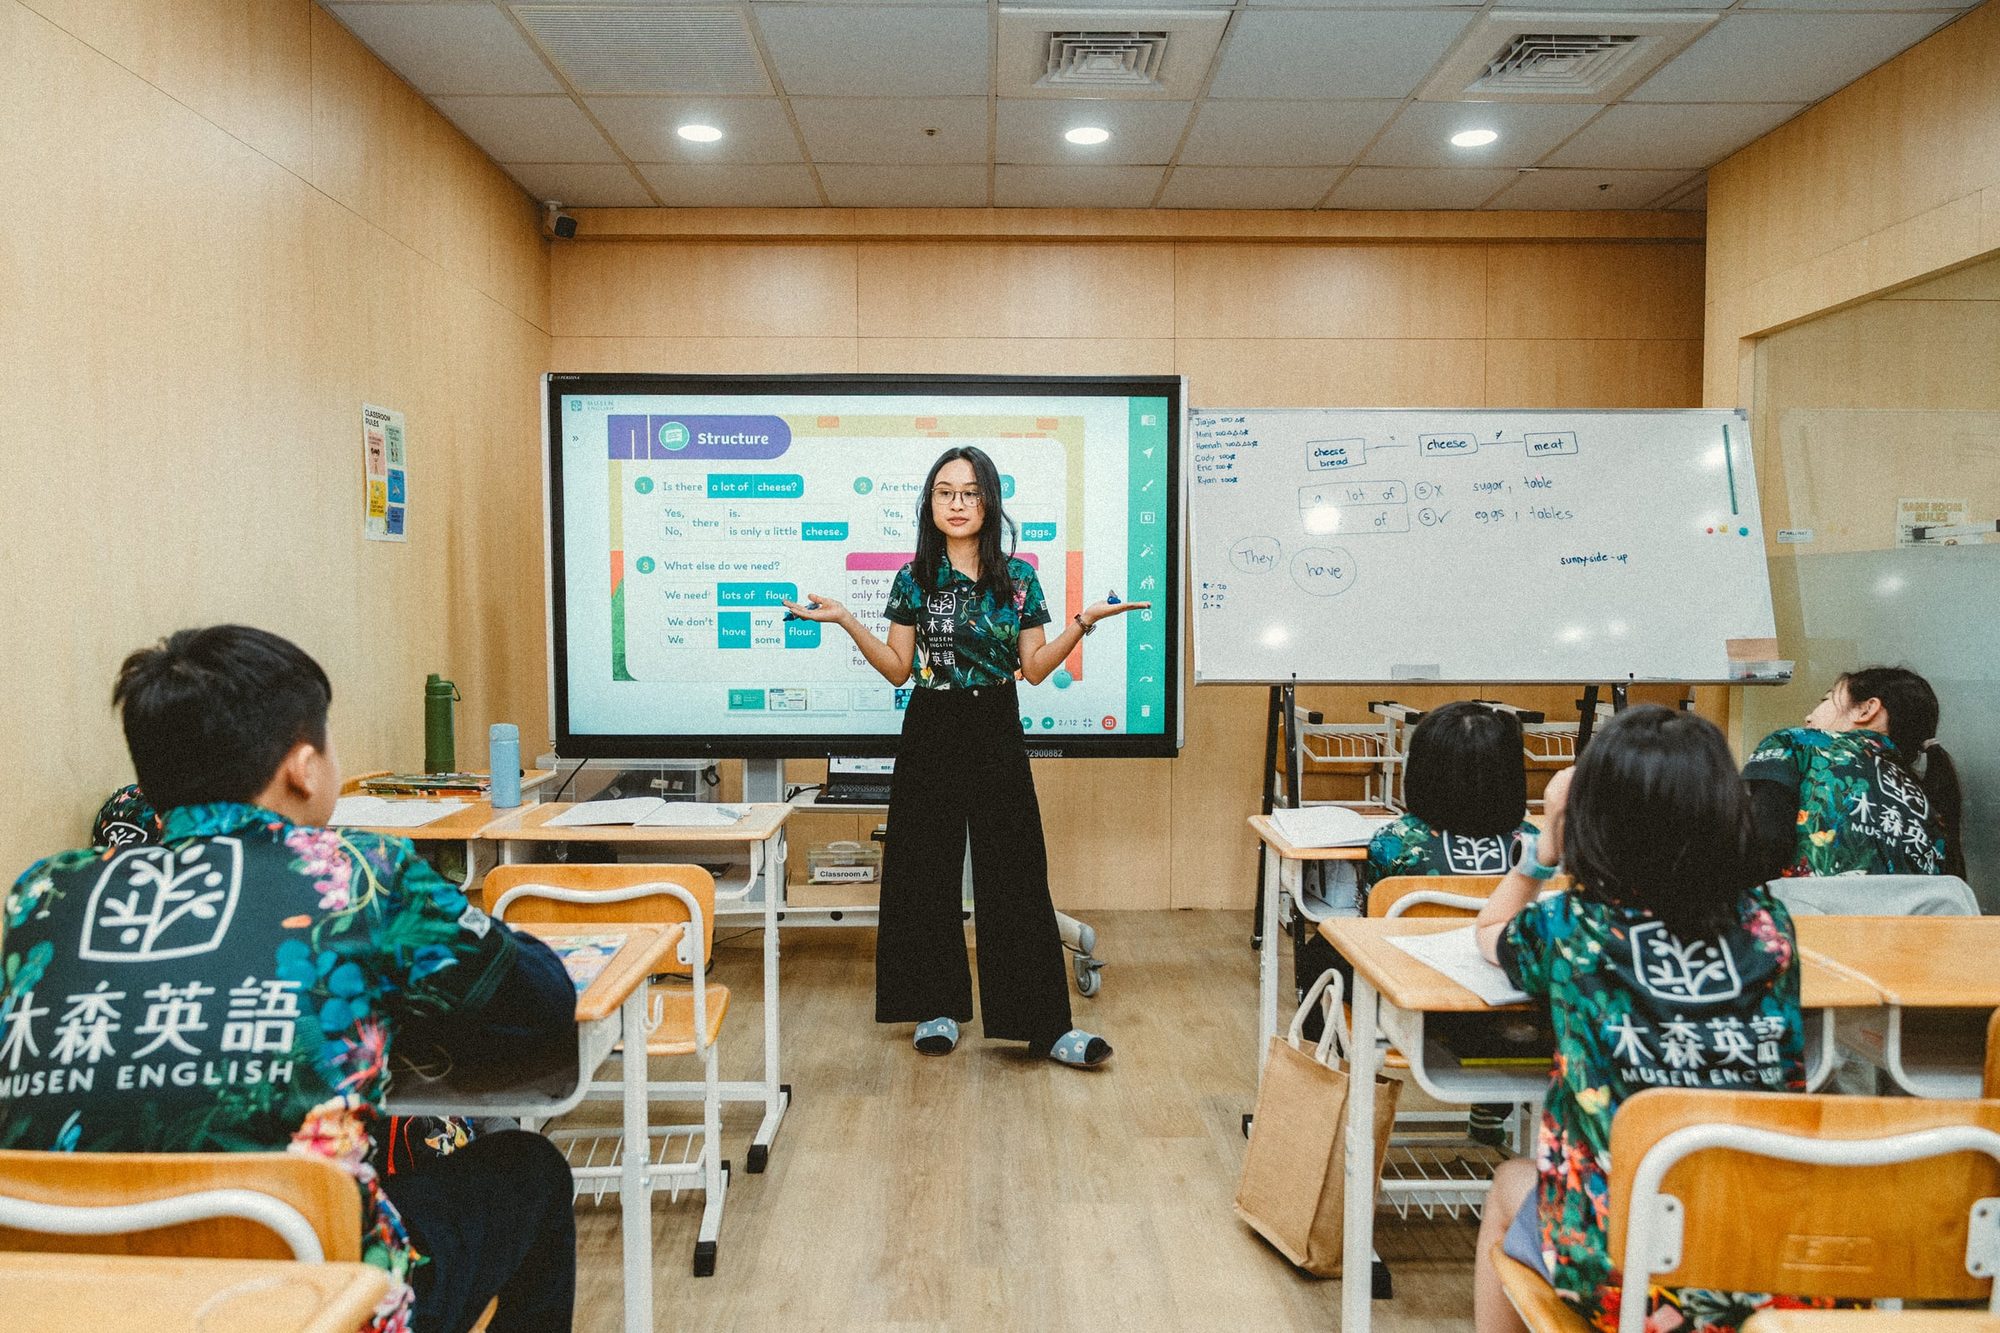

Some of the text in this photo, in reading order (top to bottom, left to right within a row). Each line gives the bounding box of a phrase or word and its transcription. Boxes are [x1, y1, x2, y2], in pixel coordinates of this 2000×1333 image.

[698, 432, 769, 446] Structure
[1427, 438, 1468, 450] cheese
[1534, 439, 1564, 450] meat
[1314, 448, 1346, 457] cheese
[1320, 458, 1348, 468] bread
[1198, 476, 1216, 484] Ryan
[1524, 476, 1552, 489] table
[663, 482, 673, 492] Is
[676, 482, 702, 492] there
[720, 482, 733, 492] lot
[735, 482, 749, 492] of
[757, 482, 798, 492] cheese?
[859, 482, 867, 492] 2
[880, 483, 924, 492] Are ther
[1346, 488, 1364, 501] lot
[1382, 486, 1395, 500] of
[664, 508, 685, 520] Yes,
[729, 508, 741, 518] is.
[883, 508, 904, 519] Yes,
[1529, 506, 1574, 520] tables
[692, 518, 720, 528] there
[1374, 512, 1388, 526] of
[664, 527, 683, 538] No,
[729, 527, 738, 536] is
[740, 527, 762, 539] only
[772, 527, 798, 536] little
[806, 527, 844, 537] cheese.
[883, 527, 901, 537] No,
[1025, 528, 1052, 538] eggs.
[1238, 550, 1274, 569] They
[664, 561, 780, 571] What else do we need?
[1306, 562, 1342, 579] have
[861, 577, 880, 585] few
[664, 590, 792, 601] We need lots of flour.
[852, 590, 872, 600] only
[667, 617, 714, 627] We don't
[754, 619, 774, 630] any
[927, 616, 955, 634] 木森
[722, 627, 747, 637] have
[788, 626, 816, 637] flour.
[667, 635, 684, 644] We
[754, 636, 781, 645] some
[932, 650, 956, 666] 英語
[1851, 822, 1896, 848] MUSN
[820, 870, 868, 879] Classroom A
[0, 976, 302, 1071] 木森英語
[116, 1060, 294, 1090] ENGLISH
[1620, 1066, 1700, 1087] MUSEN
